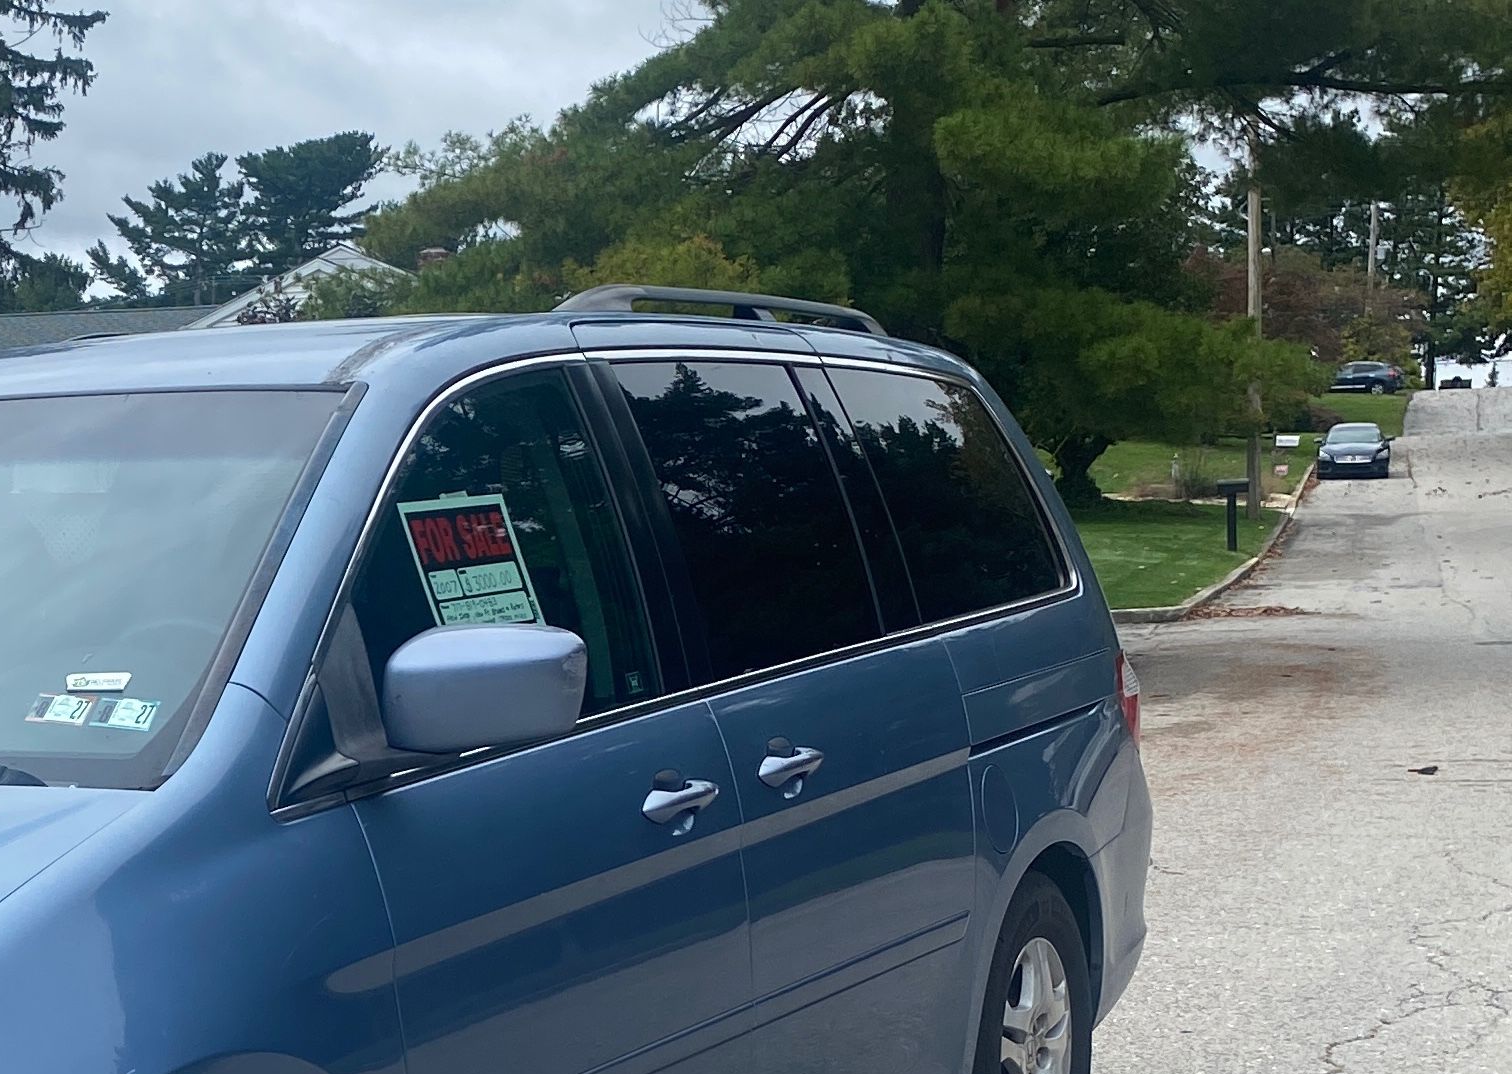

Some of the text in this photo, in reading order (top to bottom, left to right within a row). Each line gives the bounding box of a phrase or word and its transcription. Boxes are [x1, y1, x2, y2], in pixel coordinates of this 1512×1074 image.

[411, 512, 511, 564] FOR SALE
[70, 700, 90, 719] 27
[135, 704, 155, 724] 27
